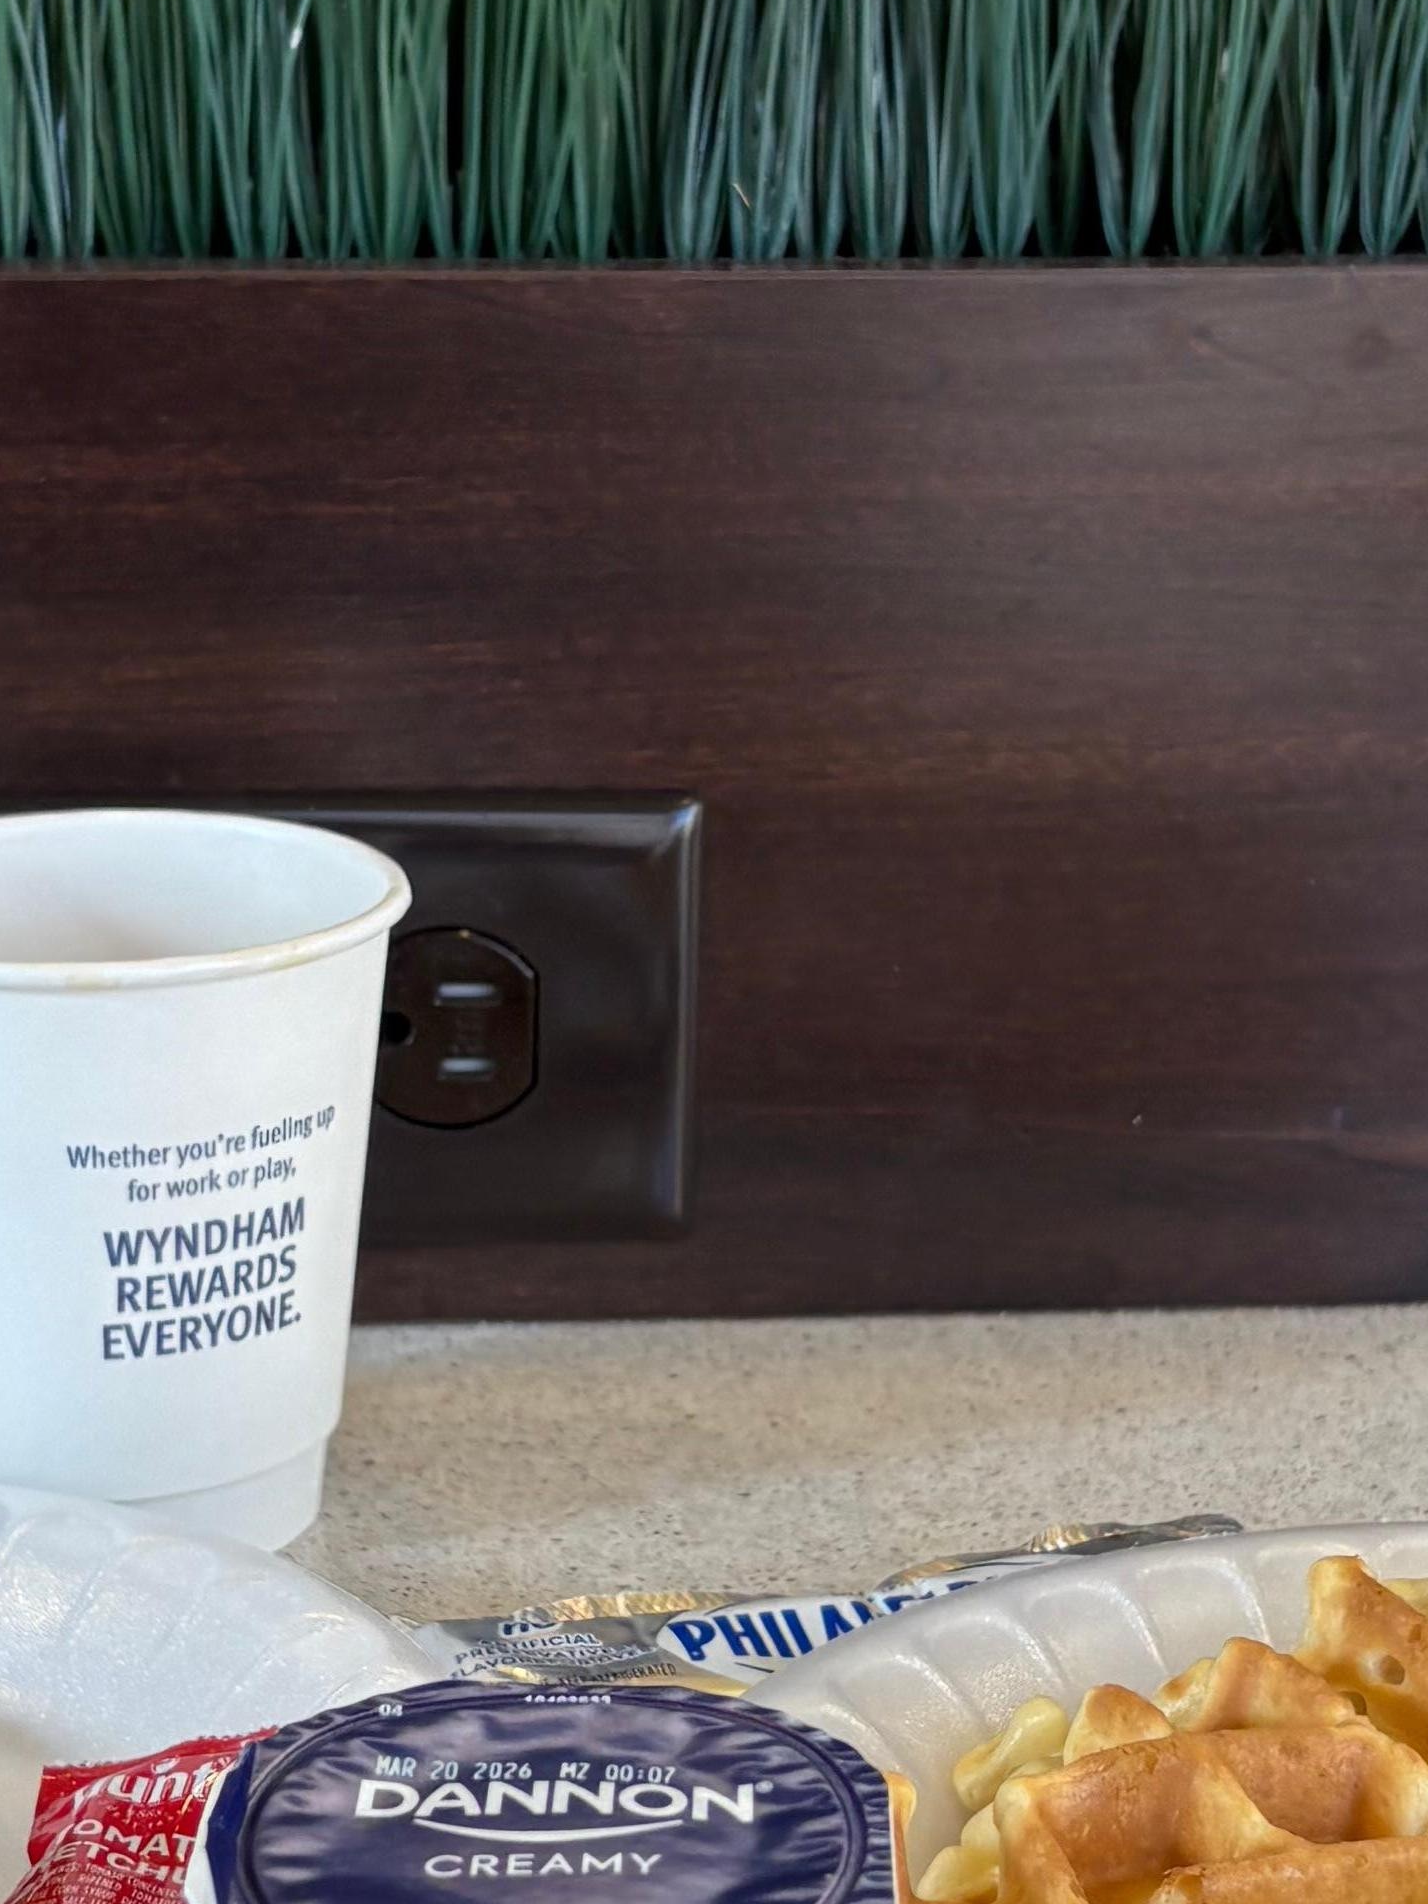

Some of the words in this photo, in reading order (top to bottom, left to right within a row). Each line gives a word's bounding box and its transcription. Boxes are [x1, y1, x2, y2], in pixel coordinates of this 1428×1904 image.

[66, 1143, 172, 1170] Whether
[176, 1133, 245, 1169] you're
[250, 1116, 313, 1151] fueling
[317, 1105, 336, 1131] up
[128, 1178, 161, 1203] for
[166, 1168, 221, 1200] work
[227, 1167, 249, 1190] or
[253, 1156, 297, 1189] play,
[102, 1196, 306, 1268] WYNDHAM
[116, 1244, 298, 1314] REWARDS
[101, 1288, 302, 1361] EVERYONE.
[378, 1703, 404, 1717] 04
[375, 1754, 417, 1778] MAR
[430, 1760, 459, 1780] 20
[473, 1761, 533, 1780] 2026
[559, 1760, 591, 1781] MZ
[604, 1763, 676, 1786] 00:07
[354, 1778, 755, 1824] DANNON
[54, 1819, 196, 1863] OMAT
[423, 1851, 664, 1879] CREAMY
